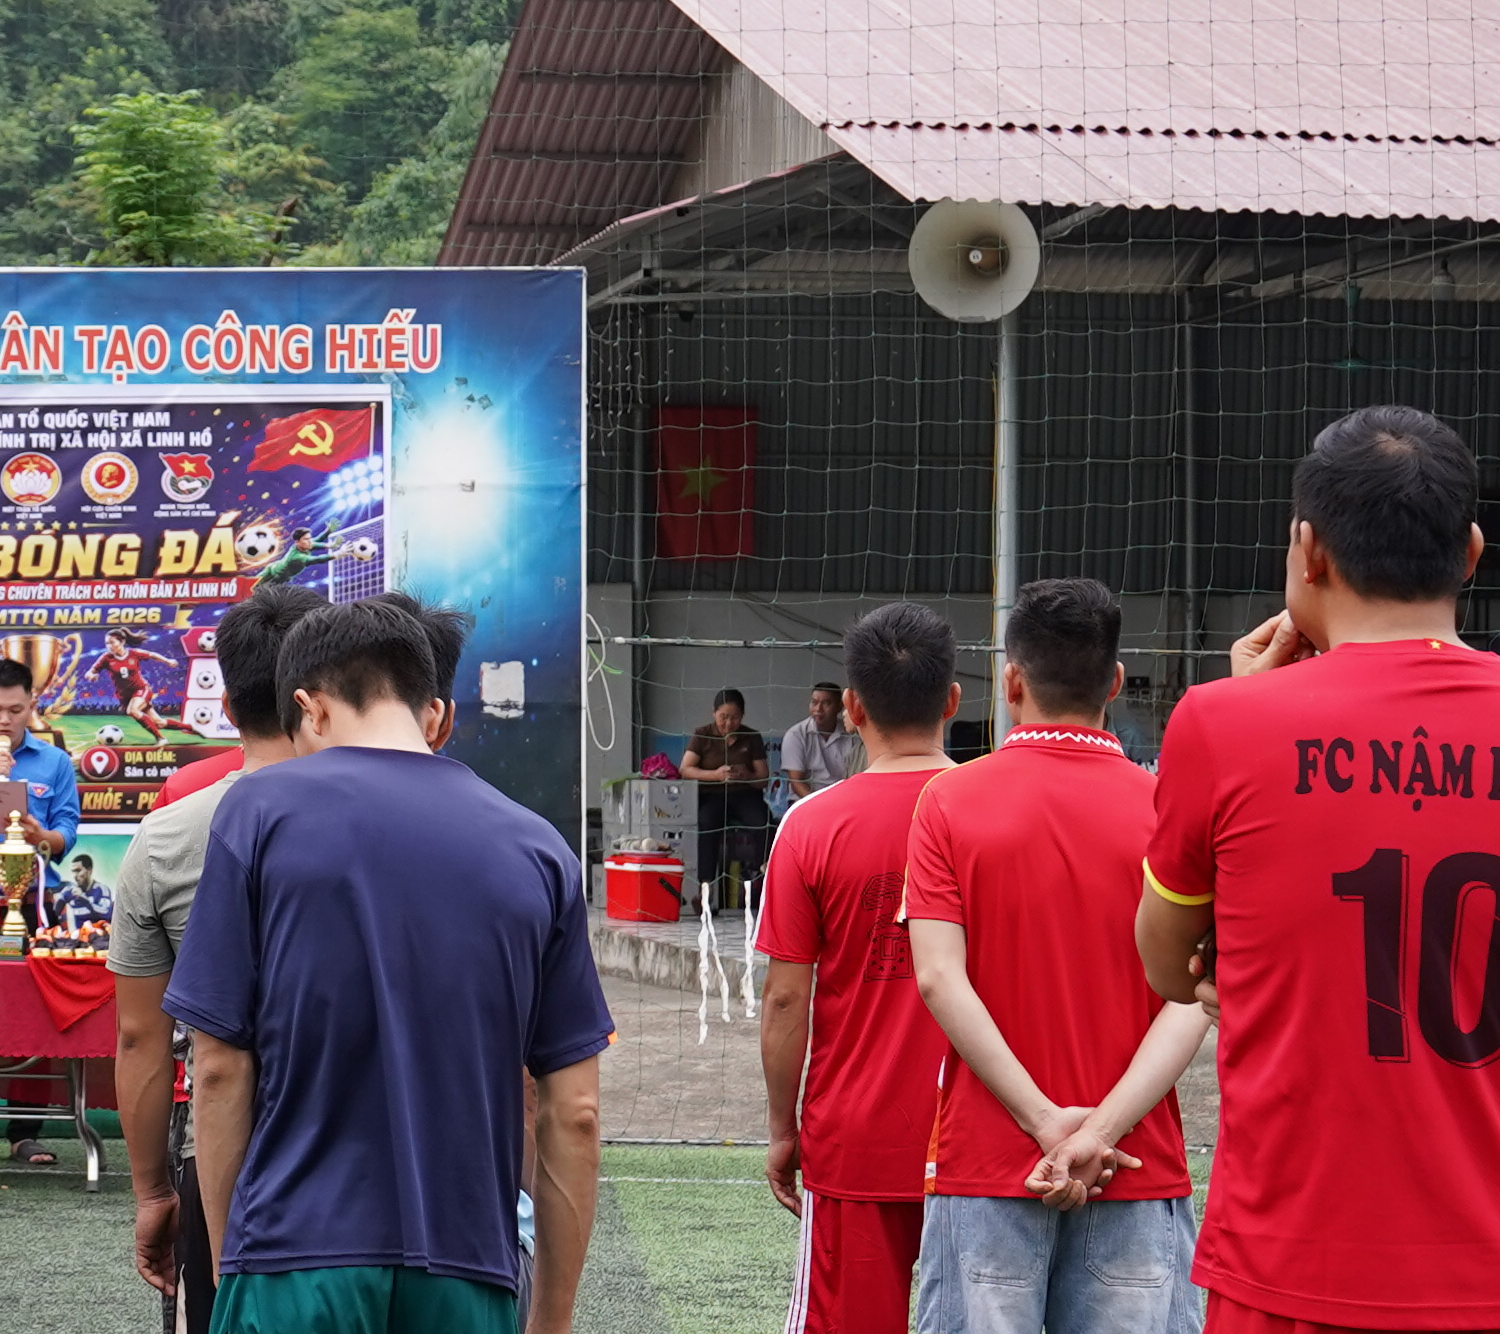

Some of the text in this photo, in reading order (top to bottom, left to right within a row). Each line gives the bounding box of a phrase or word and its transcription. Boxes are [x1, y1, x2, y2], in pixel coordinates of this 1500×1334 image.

[74, 324, 170, 383] TẠO
[182, 310, 312, 373] CÔNG
[325, 308, 441, 374] HIẾU
[43, 408, 89, 429] QUỐC
[92, 409, 129, 430] VIỆT
[132, 412, 170, 428] NAM
[29, 432, 56, 451] TRỊ
[60, 430, 83, 448] XÃ
[87, 430, 116, 451] HỘI
[120, 429, 143, 448] XÃ
[147, 431, 184, 447] LINH
[155, 514, 239, 578] ĐÁ
[8, 583, 53, 600] CHUYÊN
[55, 582, 91, 600] TRÁCH
[93, 582, 116, 599] CÁC
[118, 581, 148, 599] THÔN
[175, 580, 190, 598] XÃ
[192, 582, 218, 598] LINH
[54, 605, 101, 624] NĂM
[106, 607, 161, 624] 2026
[124, 751, 143, 765] ĐỊA
[1295, 737, 1355, 795] FC
[1369, 726, 1477, 812] NẬM
[124, 766, 144, 777] Sân
[82, 787, 123, 810] KHỎE
